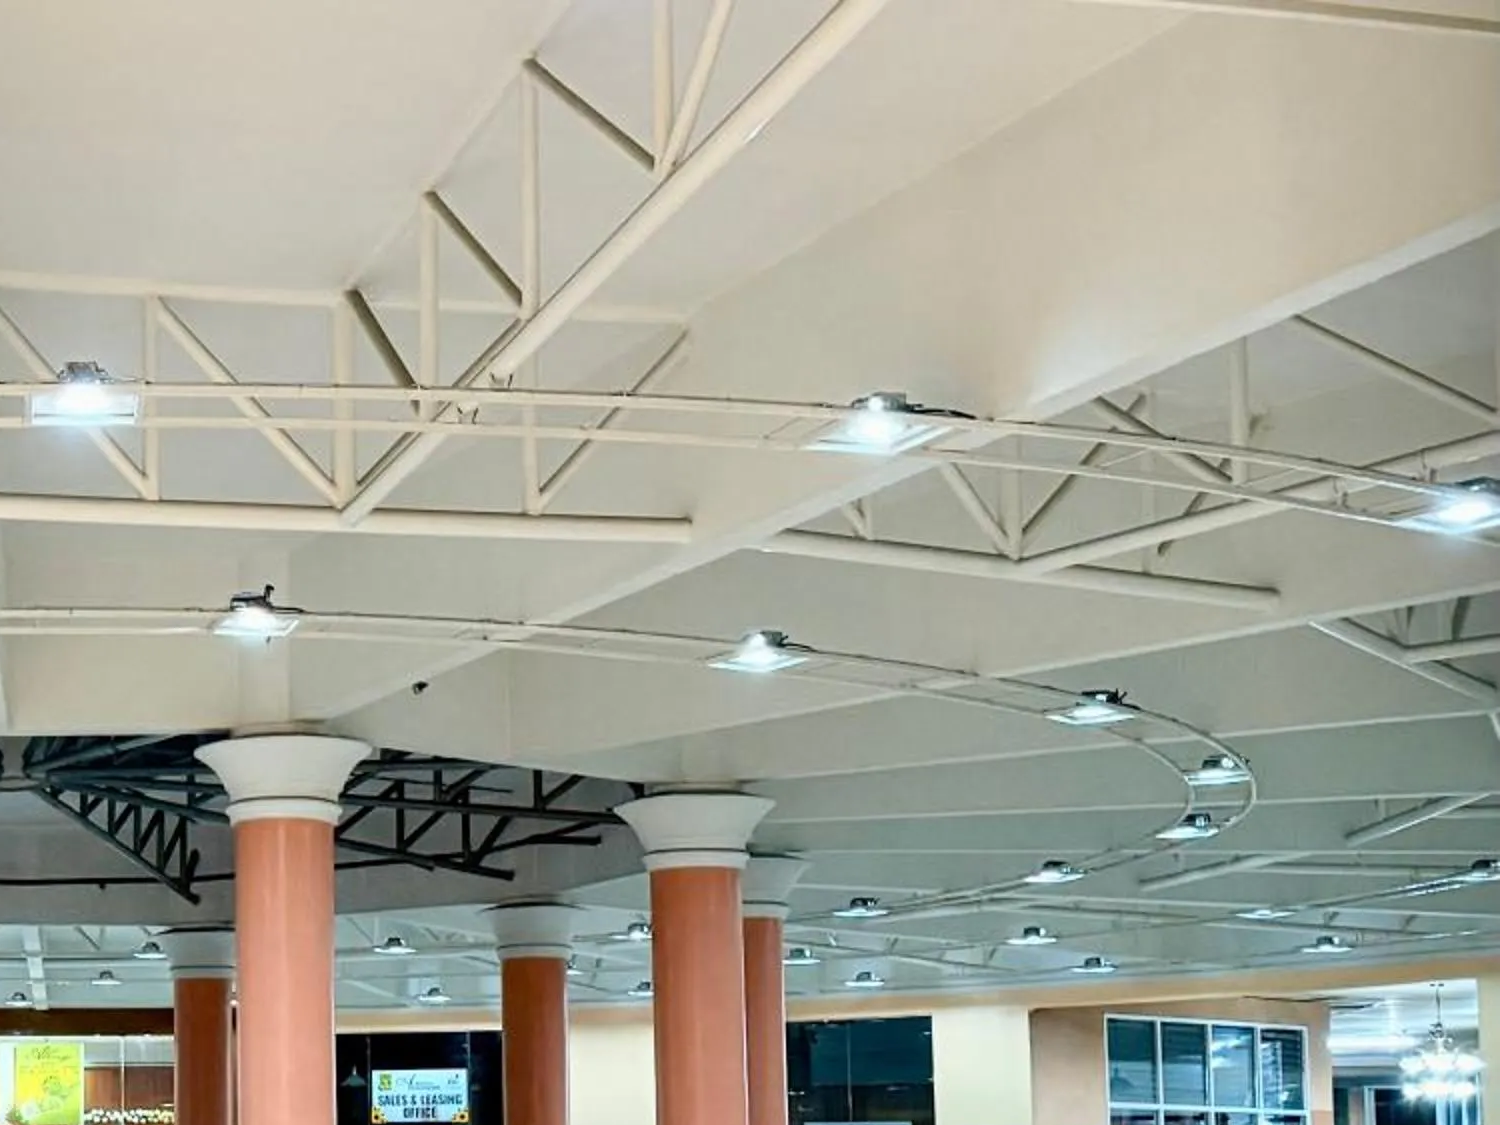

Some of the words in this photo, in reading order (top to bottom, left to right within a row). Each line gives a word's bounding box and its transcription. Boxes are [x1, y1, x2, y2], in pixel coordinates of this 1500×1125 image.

[377, 1094, 408, 1106] SALES
[420, 1094, 463, 1105] LEASING
[403, 1107, 437, 1119] OFFICE
